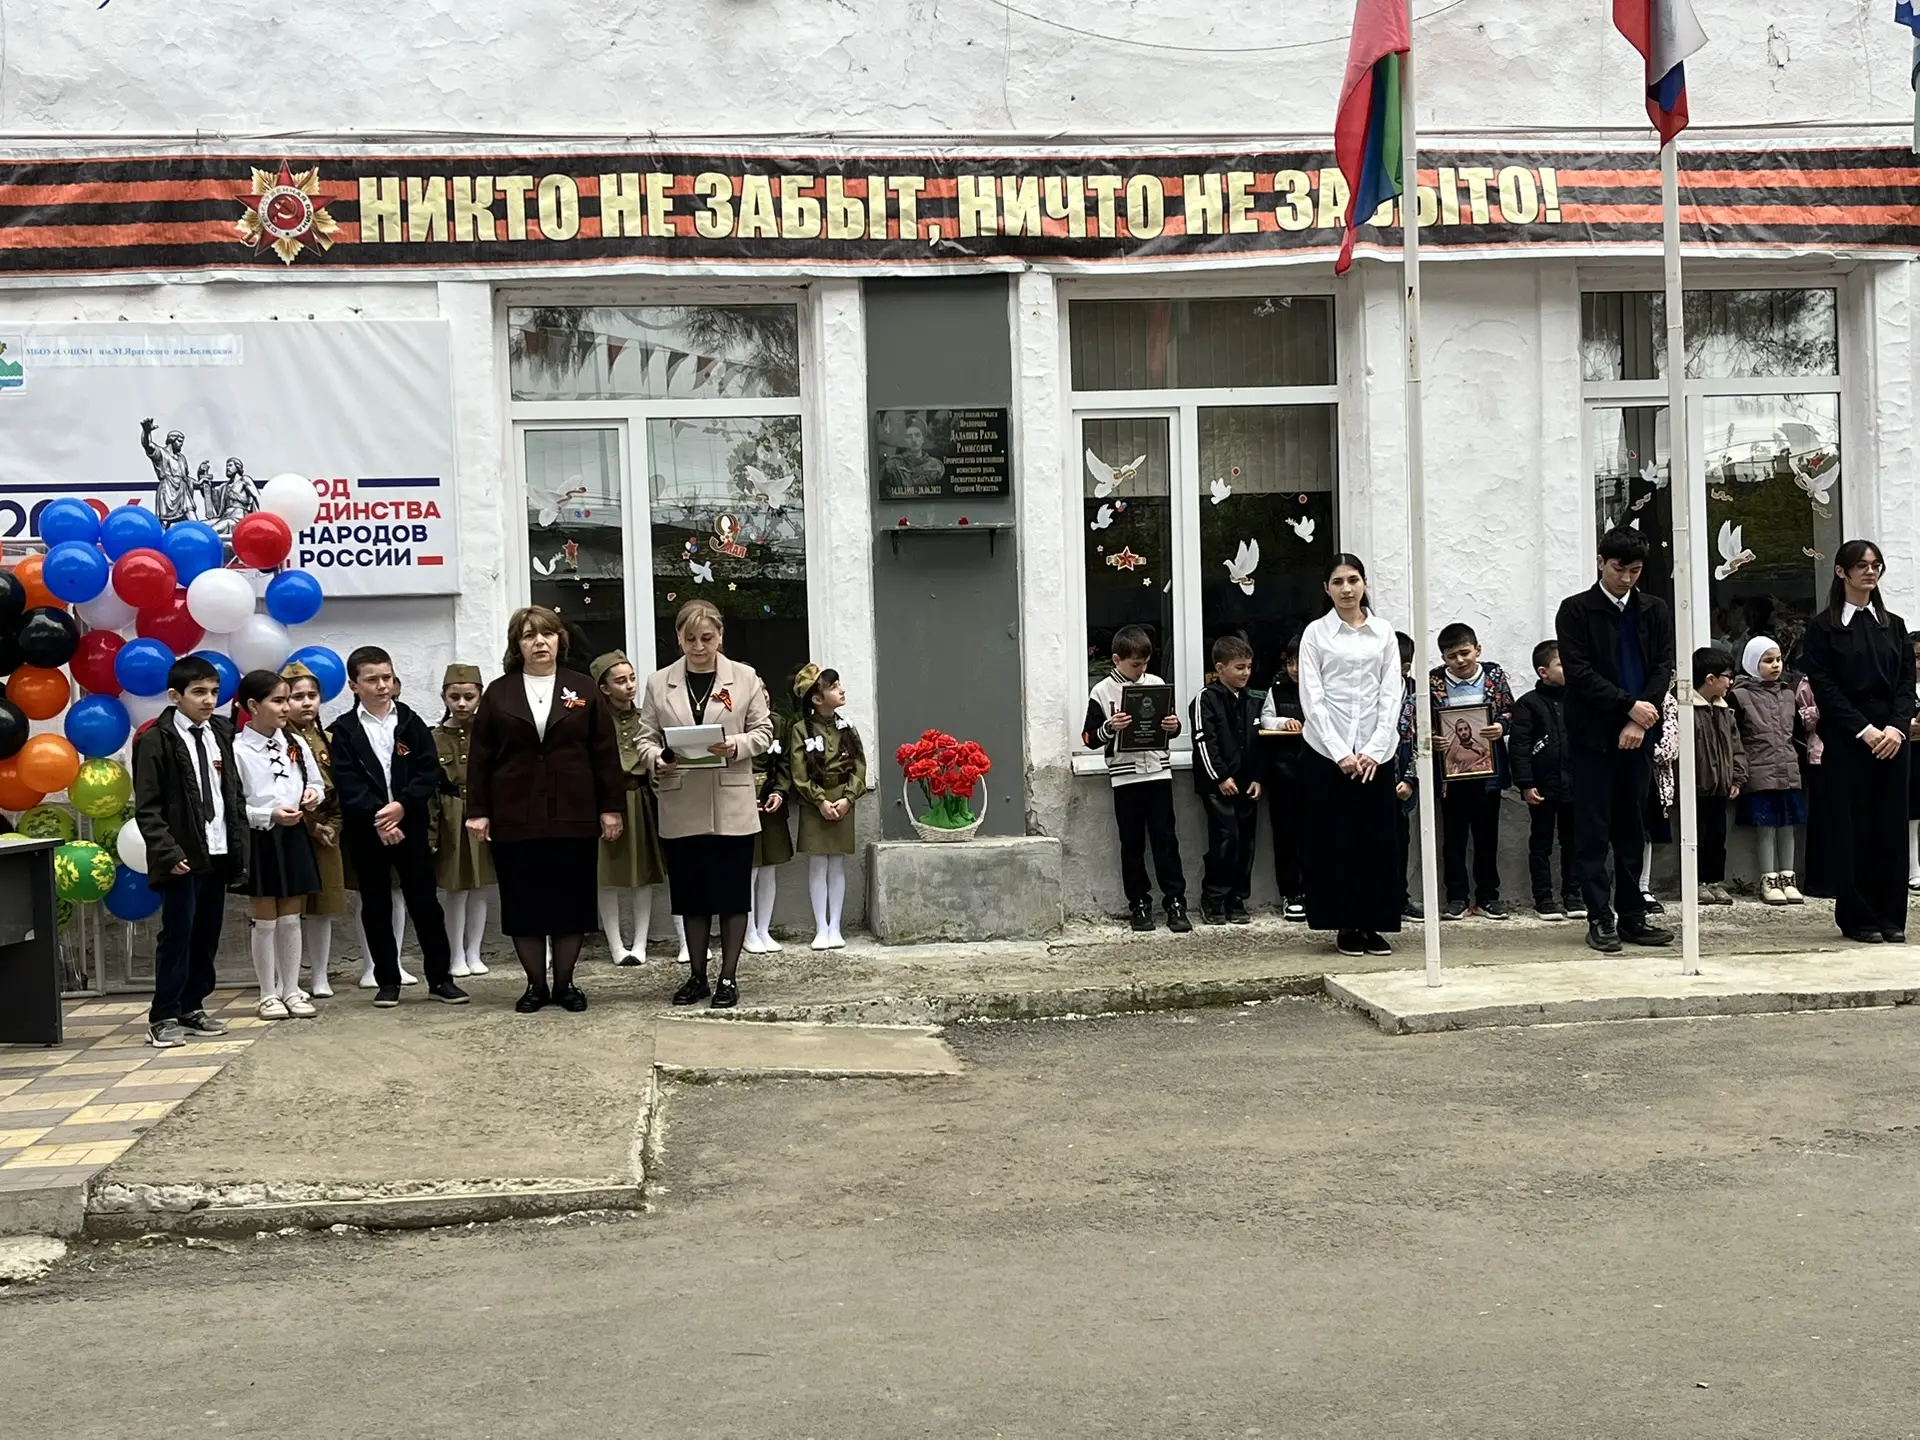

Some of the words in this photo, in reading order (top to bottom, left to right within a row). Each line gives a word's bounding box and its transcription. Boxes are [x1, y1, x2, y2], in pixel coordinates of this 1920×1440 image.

[358, 173, 580, 243] НИКТО
[599, 172, 676, 238] НЕ
[694, 172, 942, 247] ЗАБЫТ,
[957, 173, 1166, 239] НИЧТО
[1183, 171, 1260, 235] НЕ
[313, 479, 350, 500] ОД
[314, 501, 441, 523] ДИНСТВА
[299, 524, 428, 546] НАРОДОВ
[300, 548, 412, 568] РОССИИ
